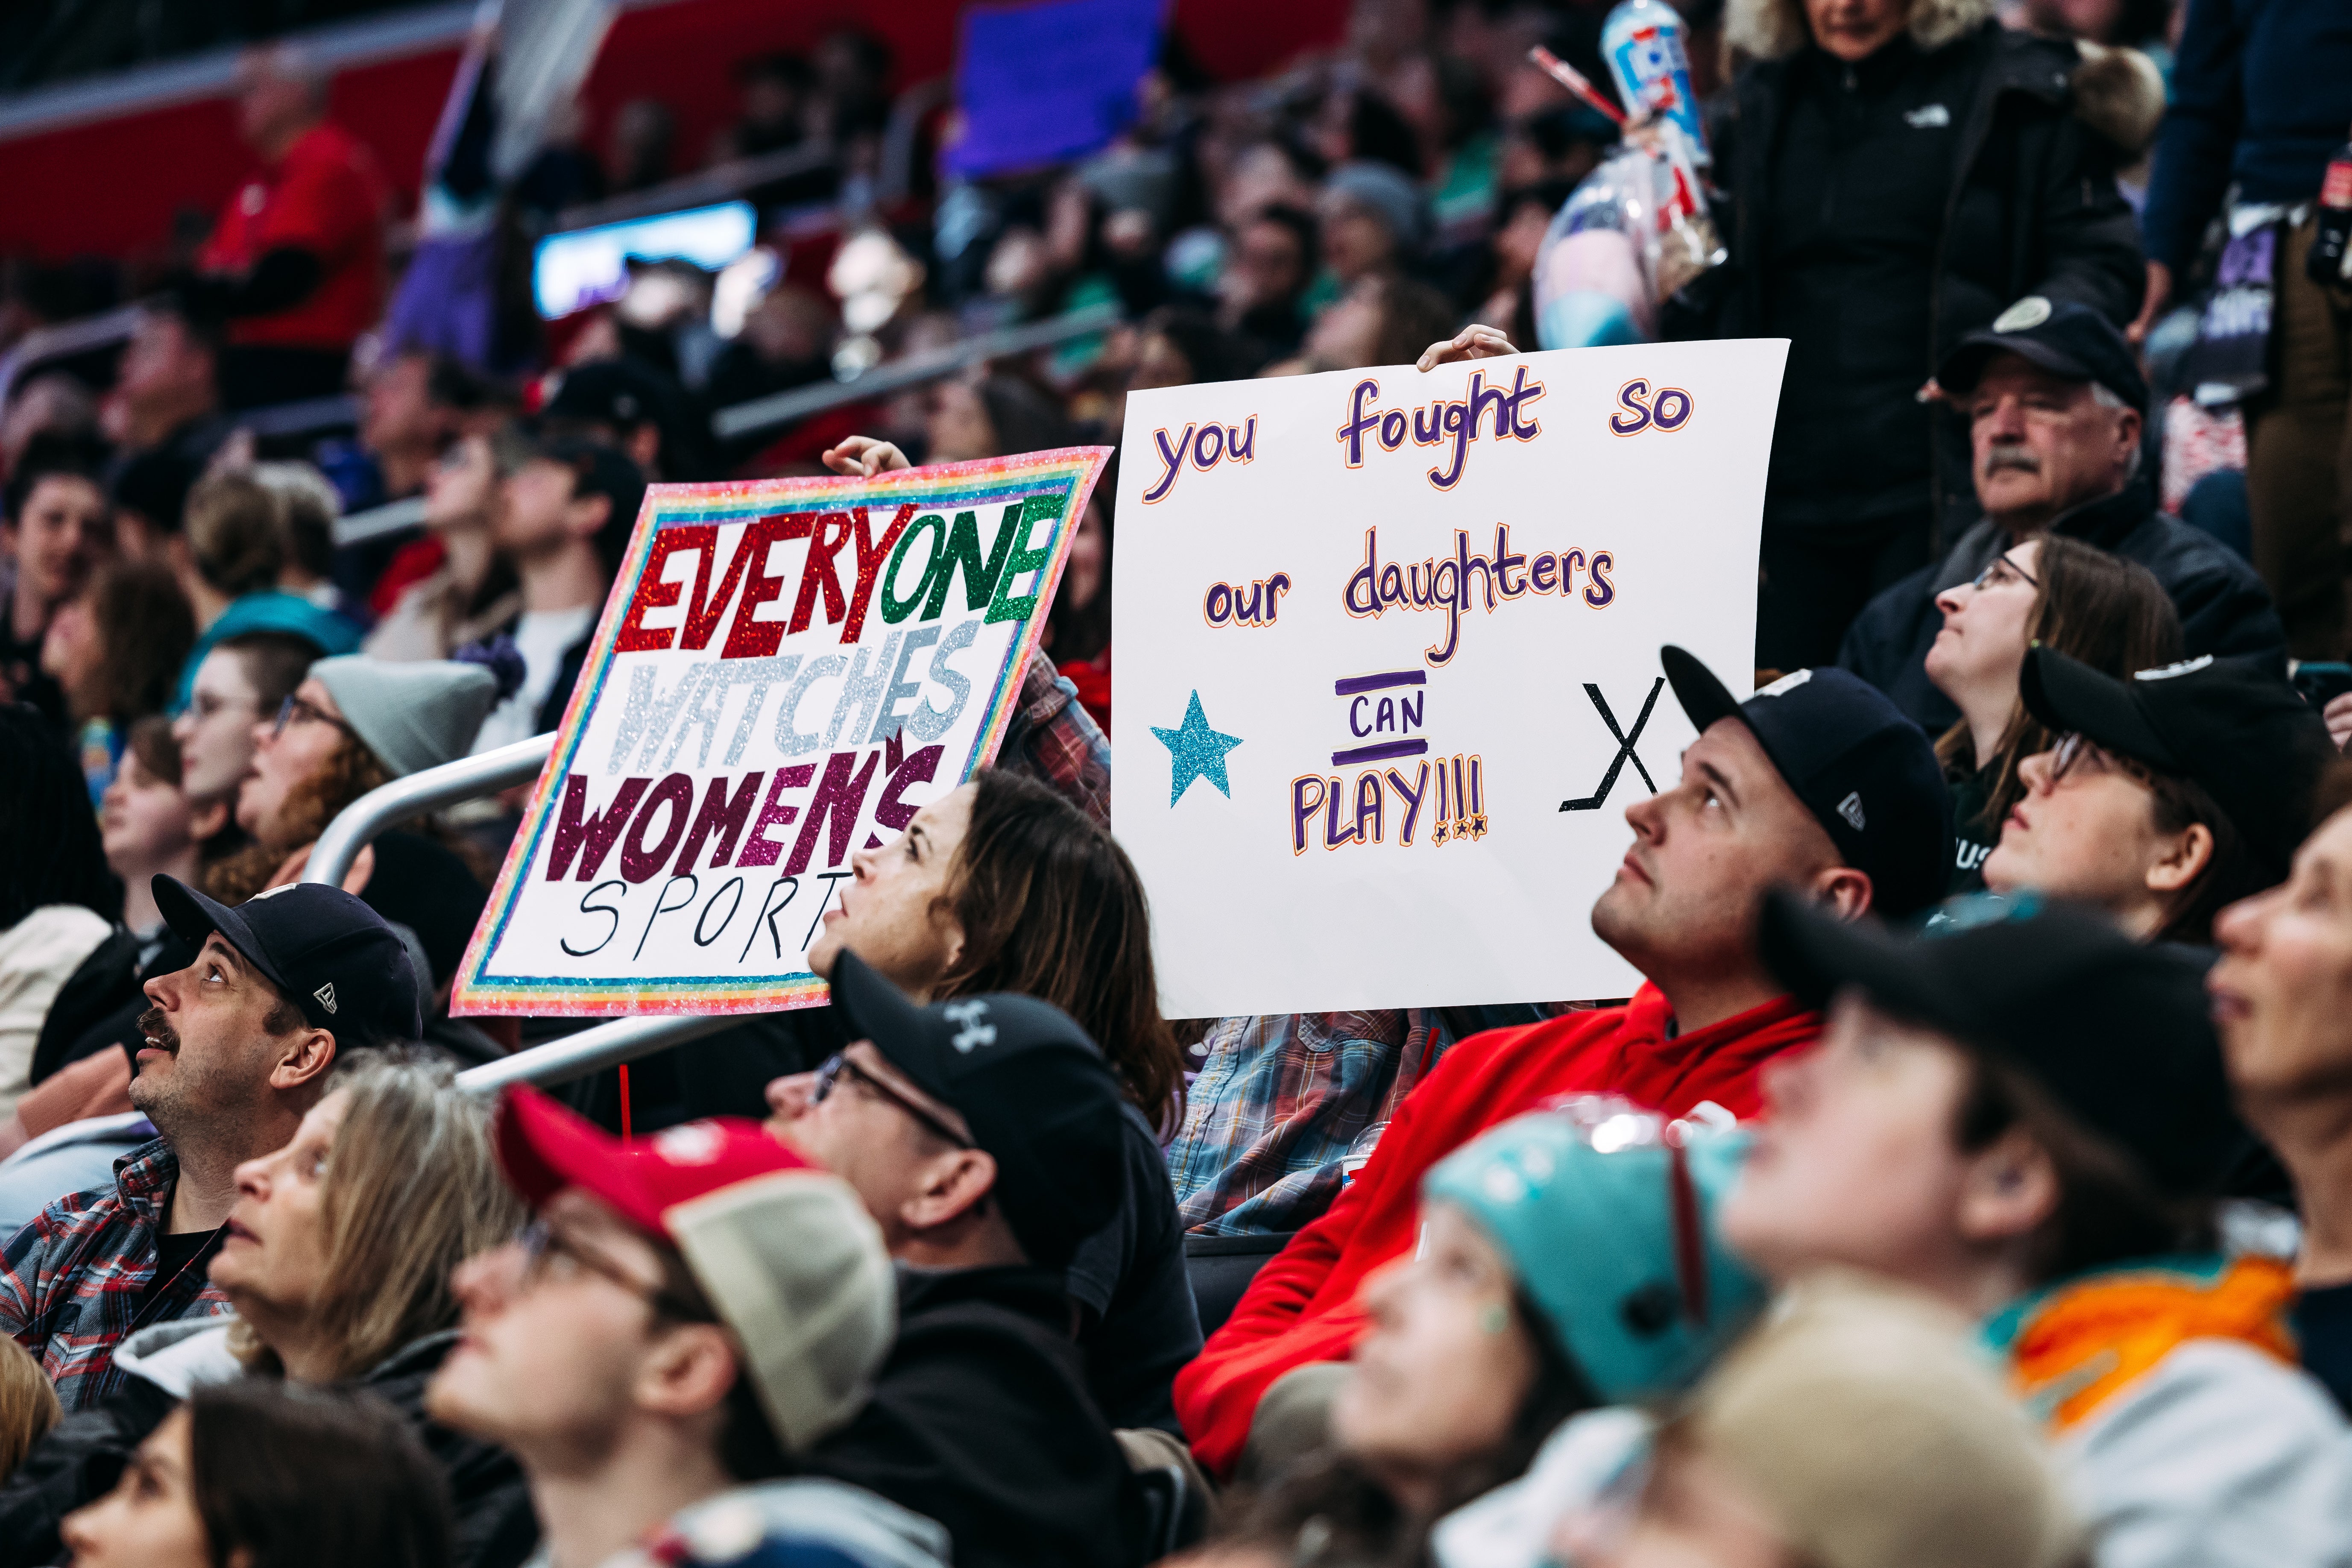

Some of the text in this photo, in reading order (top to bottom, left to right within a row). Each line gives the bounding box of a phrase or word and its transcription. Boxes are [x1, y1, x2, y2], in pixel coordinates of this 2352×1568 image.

[1142, 365, 1694, 505] you fought so
[612, 493, 1066, 660] EVERYONE
[1204, 522, 1616, 668] our daughters
[609, 620, 982, 776] WATCHES
[1350, 690, 1424, 738] CAN
[545, 724, 945, 884] WOMEN'S
[1290, 753, 1488, 857] PLAY!!!
[560, 872, 853, 963] SPORT
